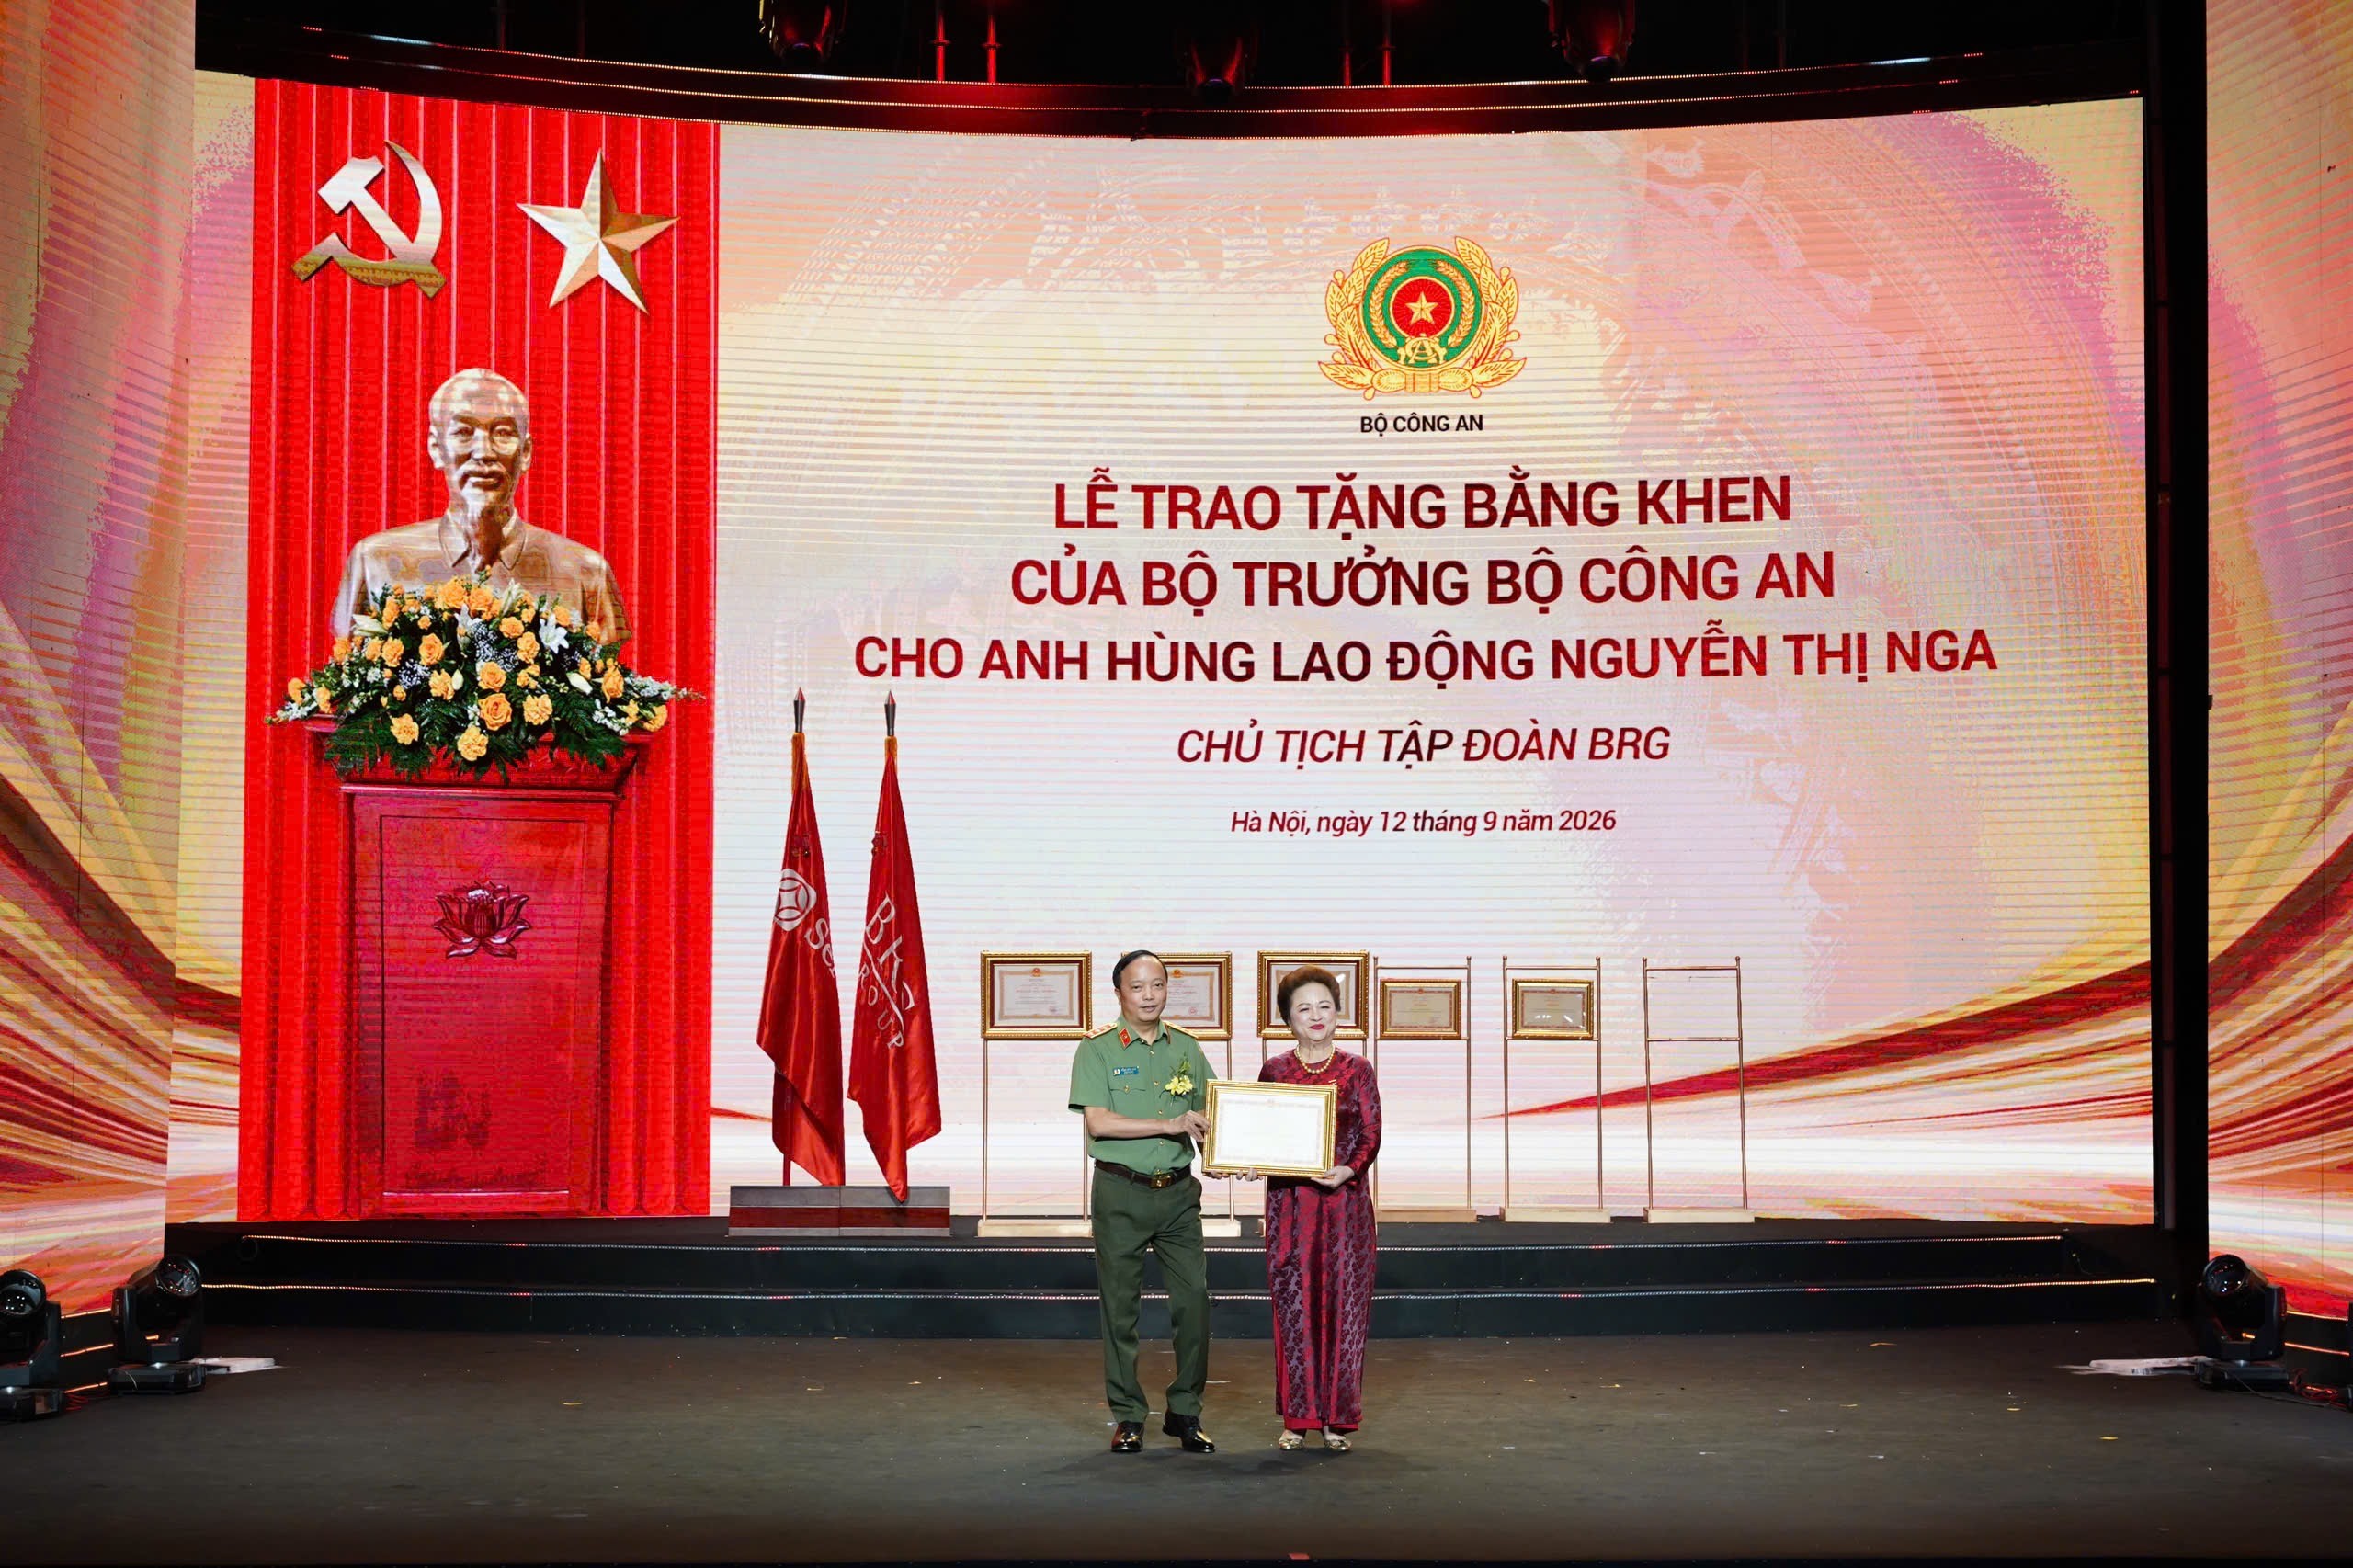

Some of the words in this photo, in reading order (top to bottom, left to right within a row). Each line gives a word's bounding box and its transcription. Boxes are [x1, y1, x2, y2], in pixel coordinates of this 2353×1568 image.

[1360, 412, 1388, 437] BỘ
[1392, 412, 1450, 433] CÔNG
[1455, 414, 1483, 432] AN
[1055, 467, 1119, 529] LỄ
[1131, 484, 1281, 531] TRAO
[1295, 472, 1446, 540] TẶNG
[1464, 464, 1620, 528] BẰNG
[1637, 474, 1790, 525] KHEN
[1011, 542, 1128, 606] CỦA
[1142, 550, 1218, 617] BỘ
[1232, 544, 1469, 608] TRƯỞNG
[1487, 546, 1563, 615] BỘ
[1579, 544, 1739, 604] CÔNG
[1755, 551, 1835, 599] AN
[855, 636, 964, 679] CHO
[978, 639, 1088, 681] ANH
[1108, 631, 1255, 683] HÙNG
[1273, 641, 1371, 682] LAO
[1385, 629, 1534, 690] ĐỘNG
[1552, 619, 1768, 680] NGUYỄN
[1782, 632, 1869, 683] THỊ
[1886, 628, 1998, 674] NGA
[1177, 718, 1264, 763] CHỦ
[1275, 729, 1366, 770] TỊCH
[1377, 719, 1454, 770] TẬP
[1462, 718, 1578, 762] ĐOÀN
[1587, 726, 1671, 760] BRG
[1231, 810, 1262, 832] Hà
[1268, 810, 1311, 837] Nội,
[1316, 810, 1373, 837] ngày
[1381, 811, 1407, 832] 12
[1413, 809, 1477, 837] tháng
[1483, 811, 1497, 832] 9
[1502, 809, 1553, 832] năm
[1558, 809, 1617, 831] 2026
